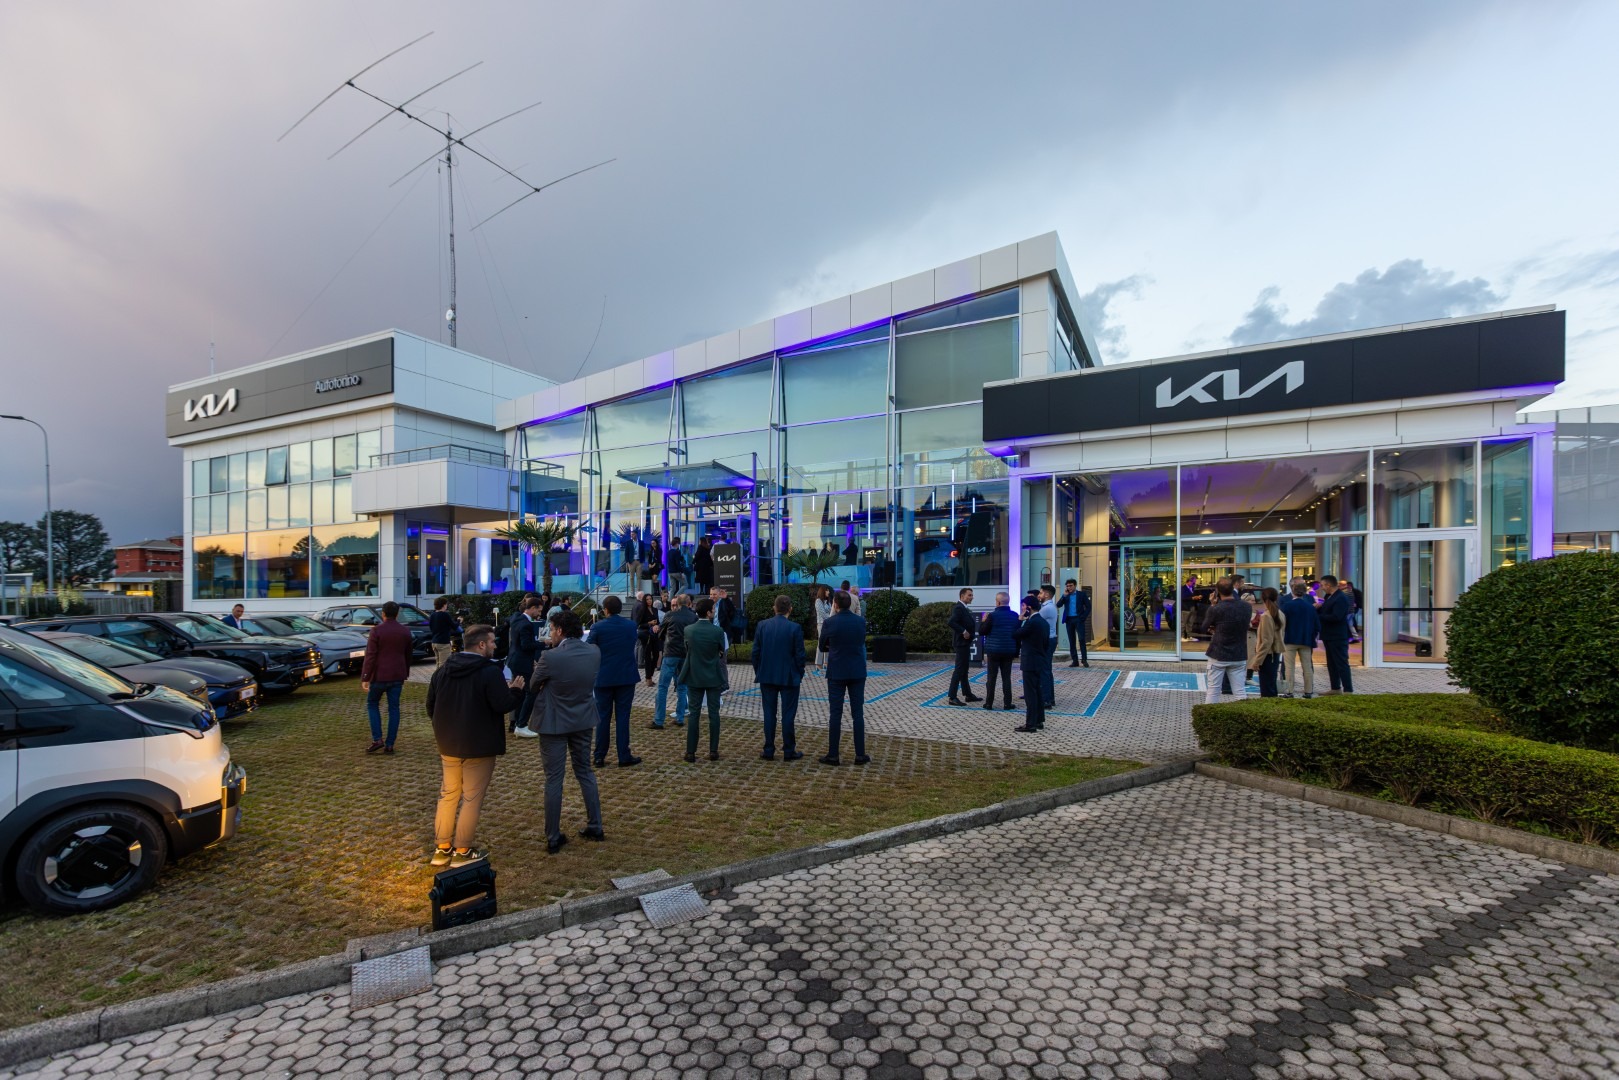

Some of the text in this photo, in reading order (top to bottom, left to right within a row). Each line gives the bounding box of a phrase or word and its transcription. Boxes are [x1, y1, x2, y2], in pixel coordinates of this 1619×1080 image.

[315, 374, 361, 394] Autotorino
[1155, 360, 1305, 409] KIA
[184, 387, 239, 422] KIA
[717, 554, 737, 562] KIA
